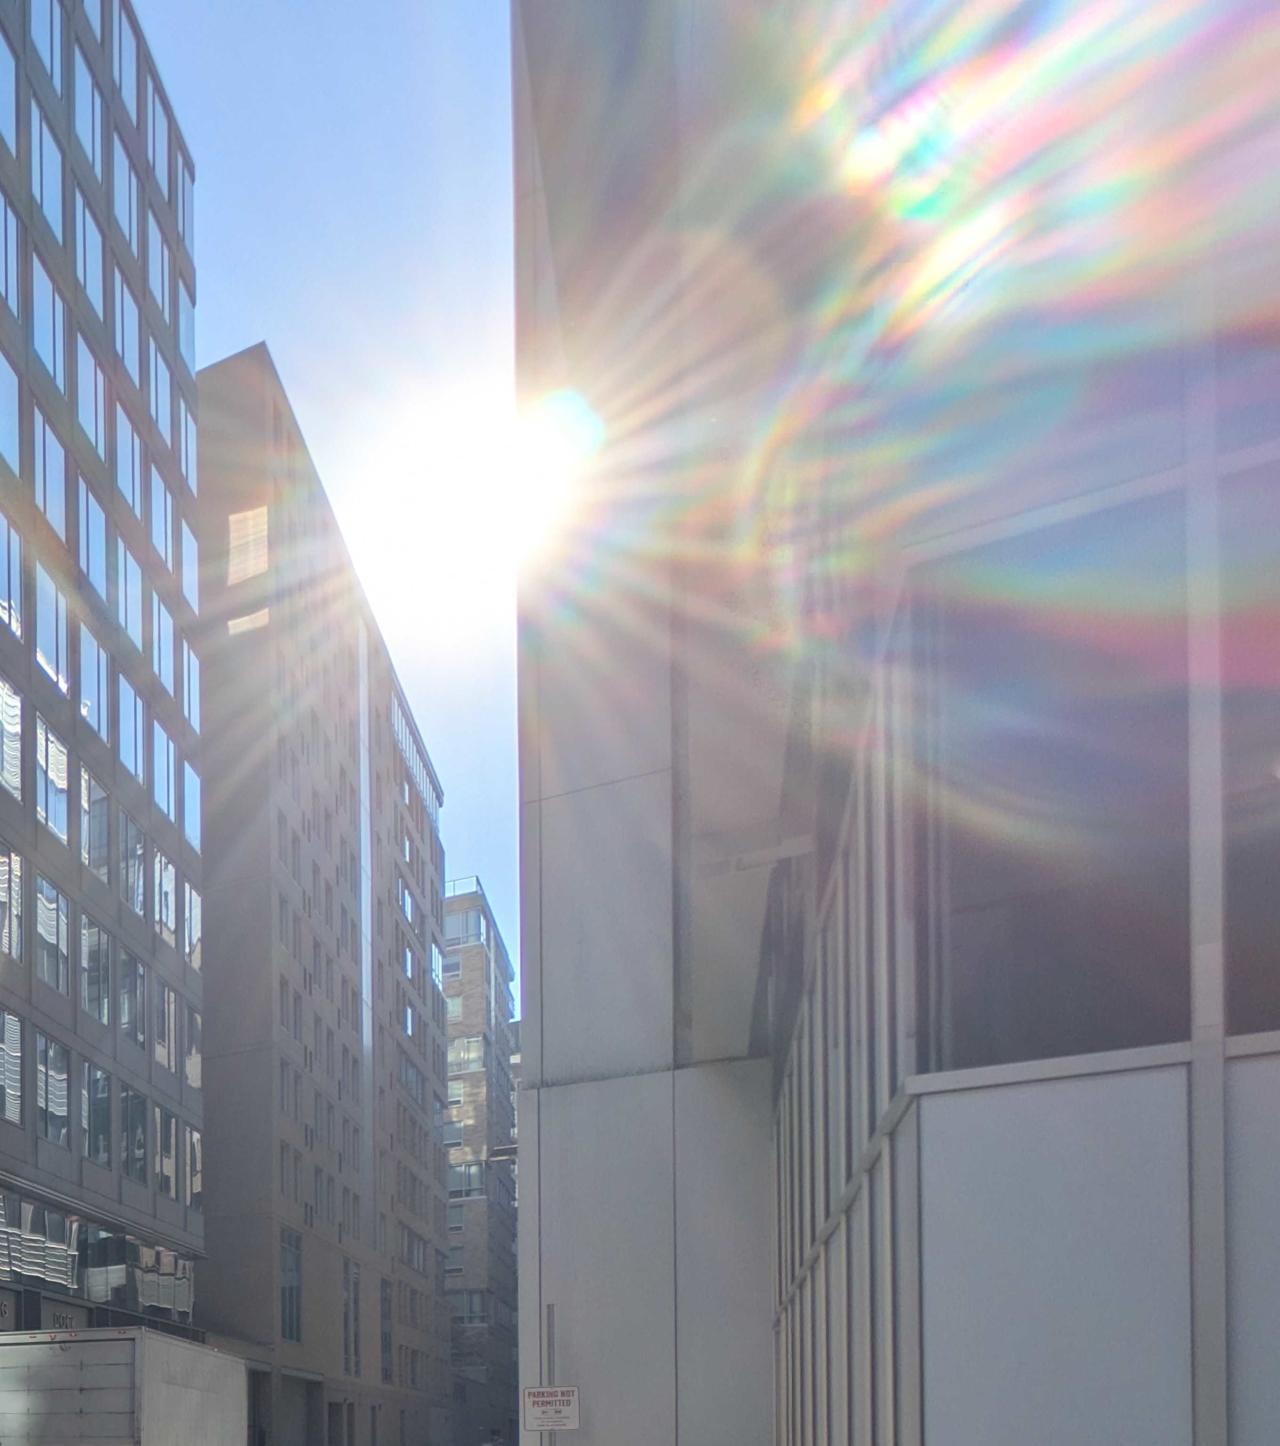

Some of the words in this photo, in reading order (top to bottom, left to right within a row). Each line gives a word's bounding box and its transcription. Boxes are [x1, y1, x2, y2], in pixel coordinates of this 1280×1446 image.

[528, 1390, 558, 1399] PARKING
[561, 1389, 575, 1398] NOT
[532, 1399, 571, 1408] PERMITTED
